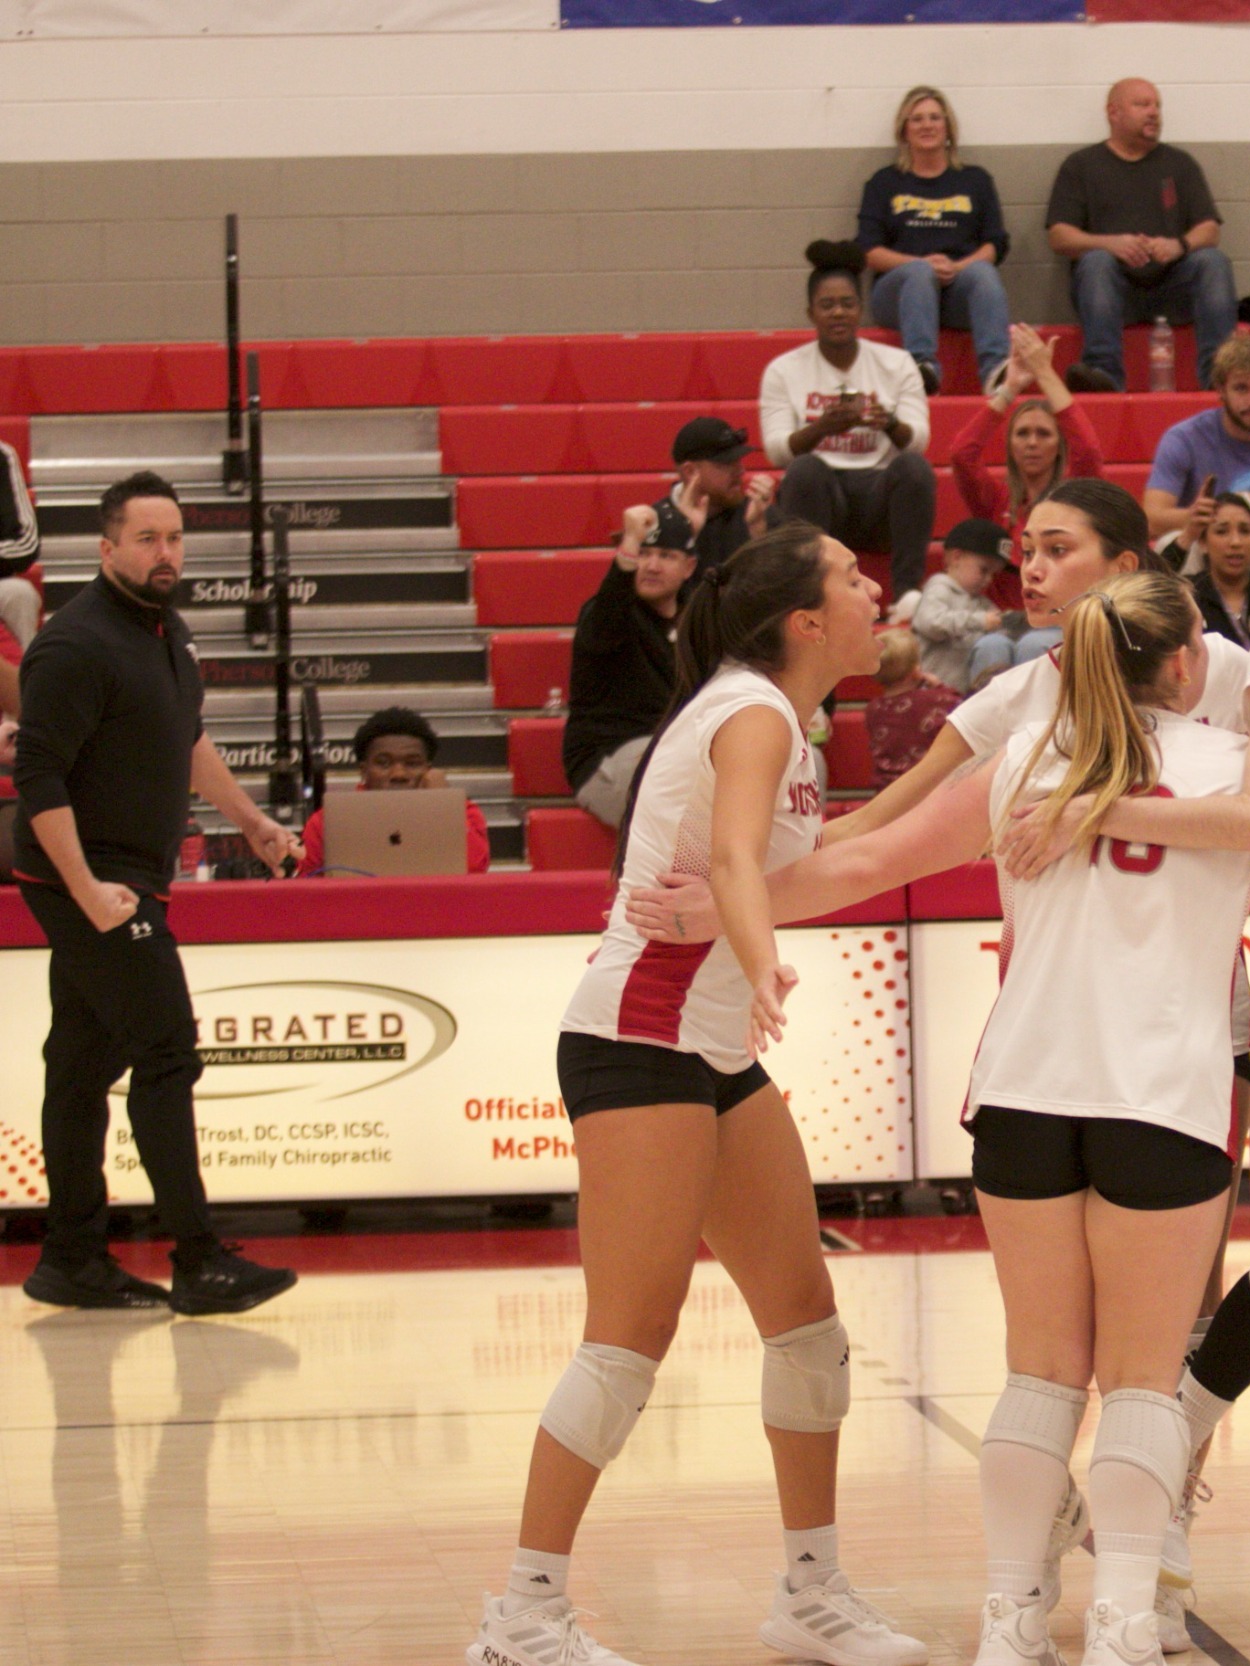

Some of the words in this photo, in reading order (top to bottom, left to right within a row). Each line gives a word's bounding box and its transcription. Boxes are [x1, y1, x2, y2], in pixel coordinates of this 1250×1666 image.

[290, 656, 371, 682] College
[201, 1049, 290, 1064] WELLNESS
[291, 1047, 361, 1063] CENTER,
[464, 1096, 567, 1121] Official
[199, 1126, 249, 1143] Trost,
[254, 1124, 284, 1142] DC,
[288, 1123, 339, 1141] CCSP,
[343, 1122, 390, 1140] ICSC,
[217, 1149, 278, 1169] Family
[282, 1147, 392, 1168] Chiropractic
